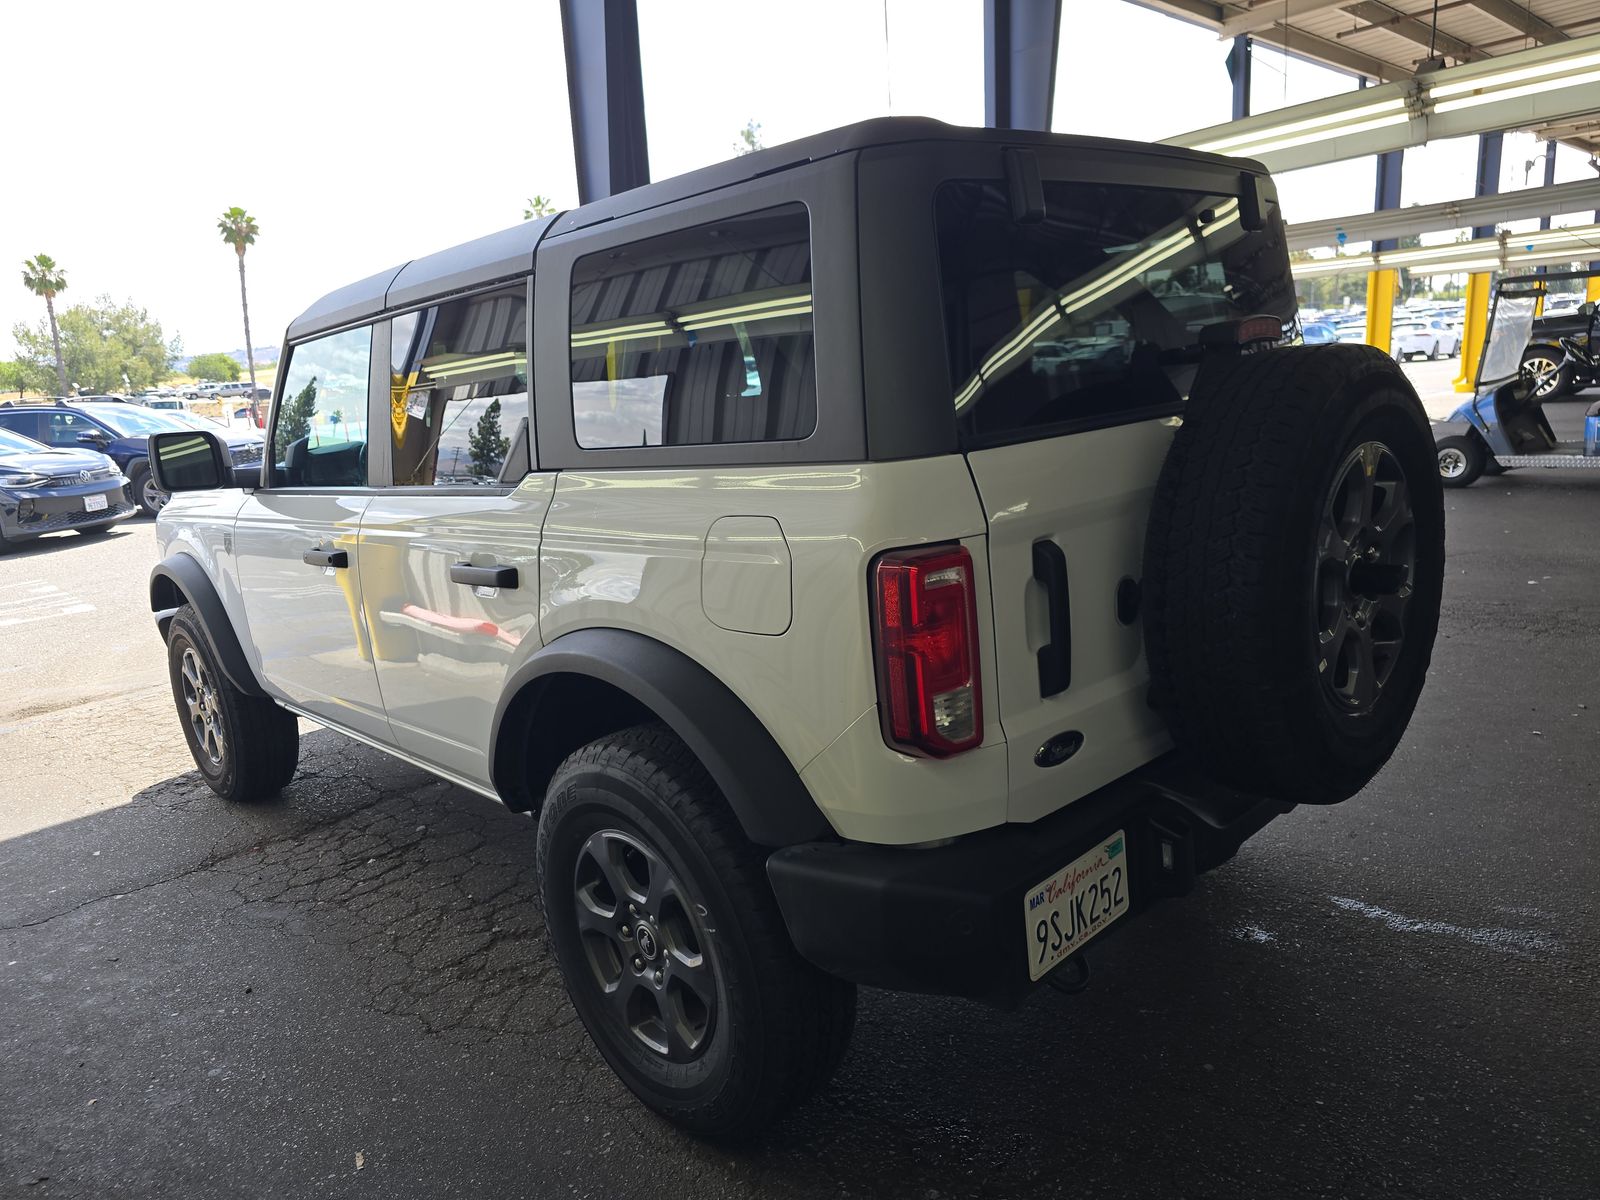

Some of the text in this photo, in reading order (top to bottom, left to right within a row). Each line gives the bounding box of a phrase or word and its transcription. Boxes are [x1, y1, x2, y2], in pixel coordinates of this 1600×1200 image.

[1029, 891, 1045, 911] MAR
[1045, 855, 1109, 904] California
[1036, 866, 1124, 965] 9SJK252
